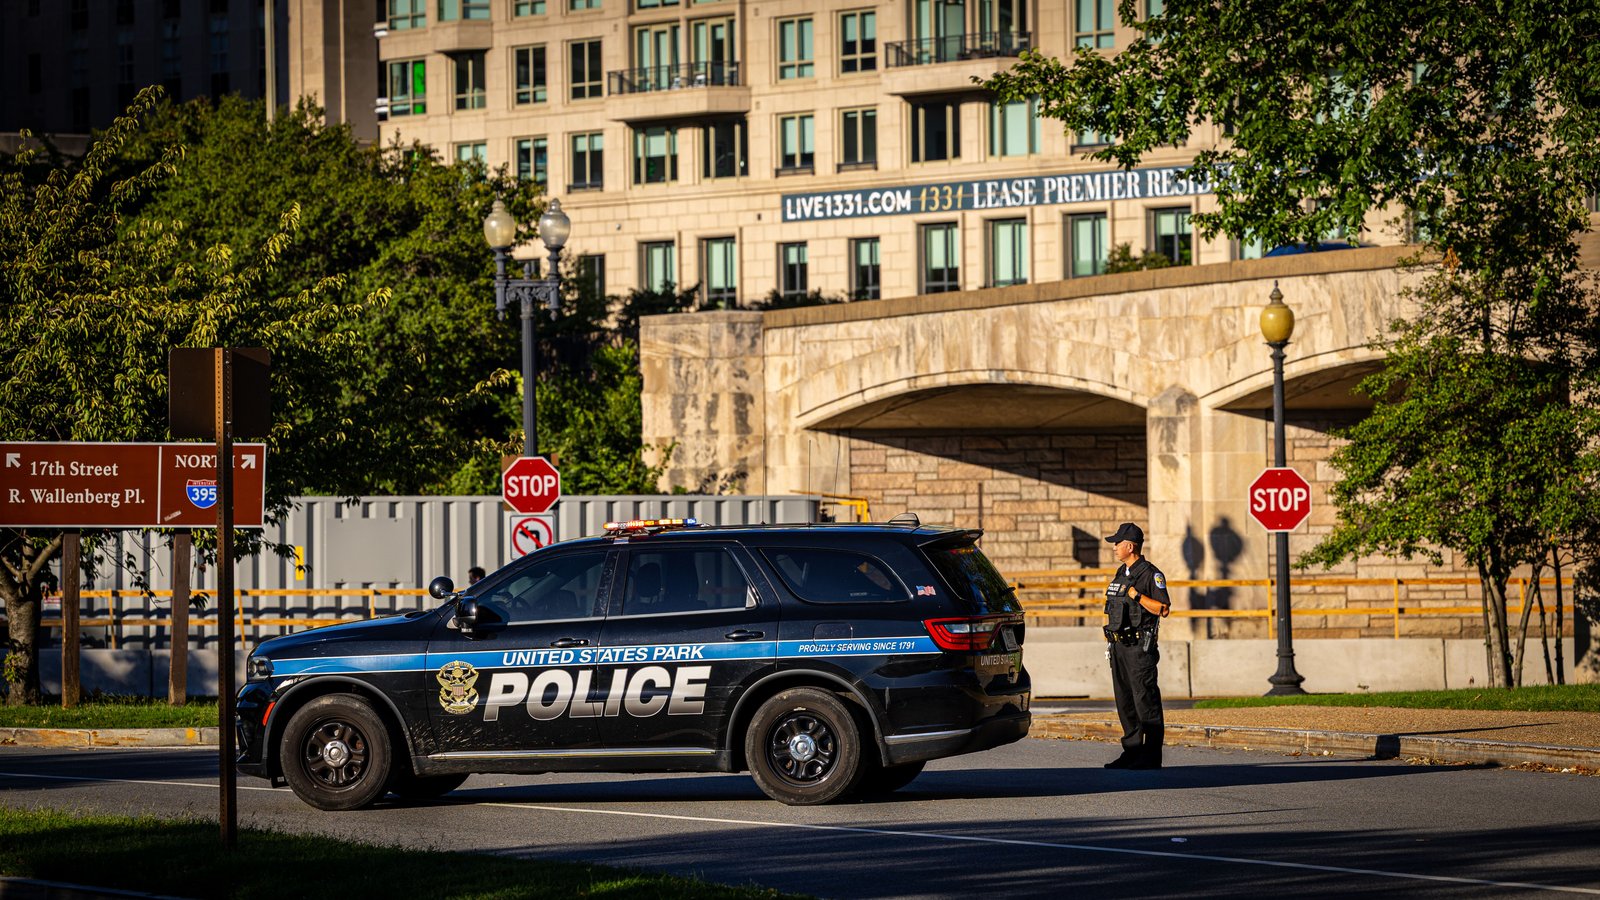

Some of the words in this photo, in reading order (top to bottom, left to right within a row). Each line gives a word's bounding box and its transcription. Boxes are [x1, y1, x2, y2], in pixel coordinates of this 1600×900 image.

[786, 189, 911, 220] LIVE1331.COM
[919, 184, 964, 212] 1331
[972, 178, 1037, 209] LEASE
[1042, 170, 1141, 204] PREMIER
[30, 460, 65, 476] 17th
[69, 461, 119, 476] Street
[191, 487, 217, 501] 395
[507, 474, 556, 497] STOP
[8, 488, 26, 504] R.
[30, 488, 120, 508] Wallenberg
[124, 488, 145, 504] Pl.
[1253, 487, 1307, 512] STOP
[502, 648, 575, 666] UNITED
[579, 647, 648, 663] STATES
[653, 645, 705, 661] PARK
[798, 644, 836, 653] PROUDLY
[836, 642, 872, 652] SERVING
[872, 641, 897, 651] SINCE
[898, 641, 915, 650] 1791
[981, 654, 1000, 666] UNITED
[483, 665, 712, 722] POLICE
